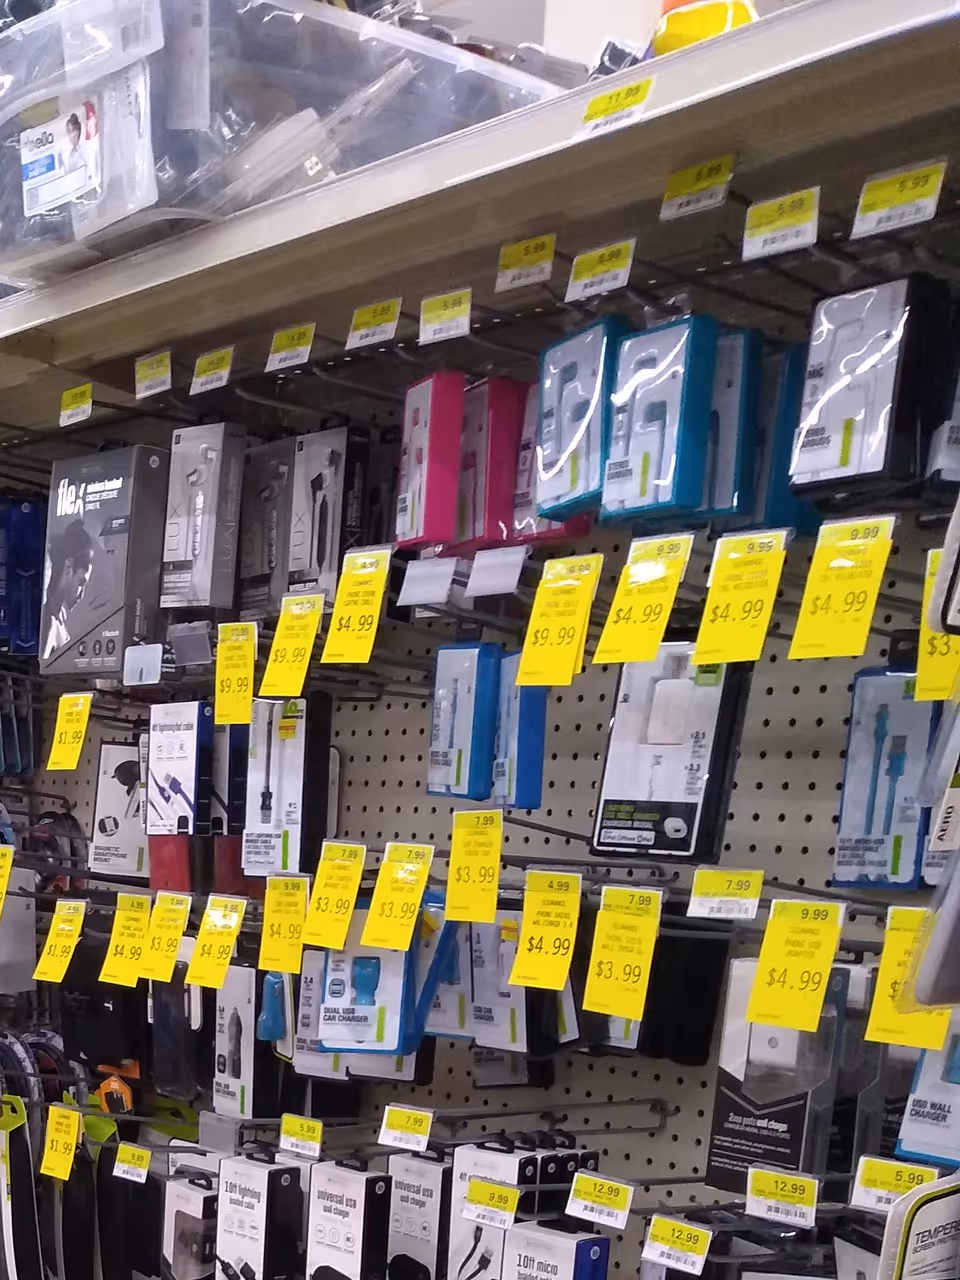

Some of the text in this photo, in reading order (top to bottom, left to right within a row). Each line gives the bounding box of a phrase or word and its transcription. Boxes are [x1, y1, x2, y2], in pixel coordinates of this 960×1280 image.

[57, 478, 85, 516] flex
[850, 526, 880, 541] 9.99
[808, 590, 868, 616] $4.99
[612, 603, 663, 625] $4.99
[709, 599, 764, 624] $4.99
[336, 614, 374, 632] $4.99
[532, 626, 576, 647] $9.99
[272, 647, 307, 664] $9.99
[220, 677, 249, 694] $9.99
[57, 729, 83, 746] $1.99
[475, 816, 495, 826] 7.99
[342, 848, 358, 859] 7.99
[407, 849, 426, 860] 7.99
[455, 865, 495, 884] $3.99
[284, 882, 300, 891] 9.99
[547, 881, 570, 892] 4.99
[726, 879, 751, 891] 7.99
[315, 896, 351, 915] $3.99
[629, 895, 652, 906] 7.99
[379, 901, 417, 919] $3.99
[800, 908, 829, 920] 9.99
[269, 922, 302, 940] $4.99
[47, 944, 72, 958] $1.99
[113, 944, 142, 961] $4.99
[149, 937, 178, 953] $3.99
[200, 943, 231, 961] $4.99
[526, 936, 571, 956] $4.99
[595, 960, 642, 984] $3.99
[766, 967, 823, 992] $4.99
[323, 1006, 356, 1016] DUAL USB
[323, 1014, 369, 1023] CAR CHARGER
[912, 1099, 952, 1114] USB WALL
[406, 1116, 423, 1127] 7.99
[909, 1108, 948, 1123] CHARGER
[300, 1123, 316, 1134] 5.99
[49, 1138, 73, 1155] $1.99
[895, 1171, 924, 1185] 5.99
[224, 1180, 262, 1203] 10ft lightning
[394, 1178, 419, 1196] universal
[592, 1182, 620, 1198] 12.99
[773, 1180, 806, 1195] 12.99
[229, 1195, 256, 1211] braided cable
[317, 1189, 342, 1206] universal
[400, 1194, 427, 1209] wall charger
[488, 1192, 509, 1205] 9.99
[323, 1204, 350, 1219] wall charger
[671, 1227, 700, 1245] 12.99
[912, 1241, 936, 1255] SCREEN
[516, 1253, 559, 1276] 10ft micro
